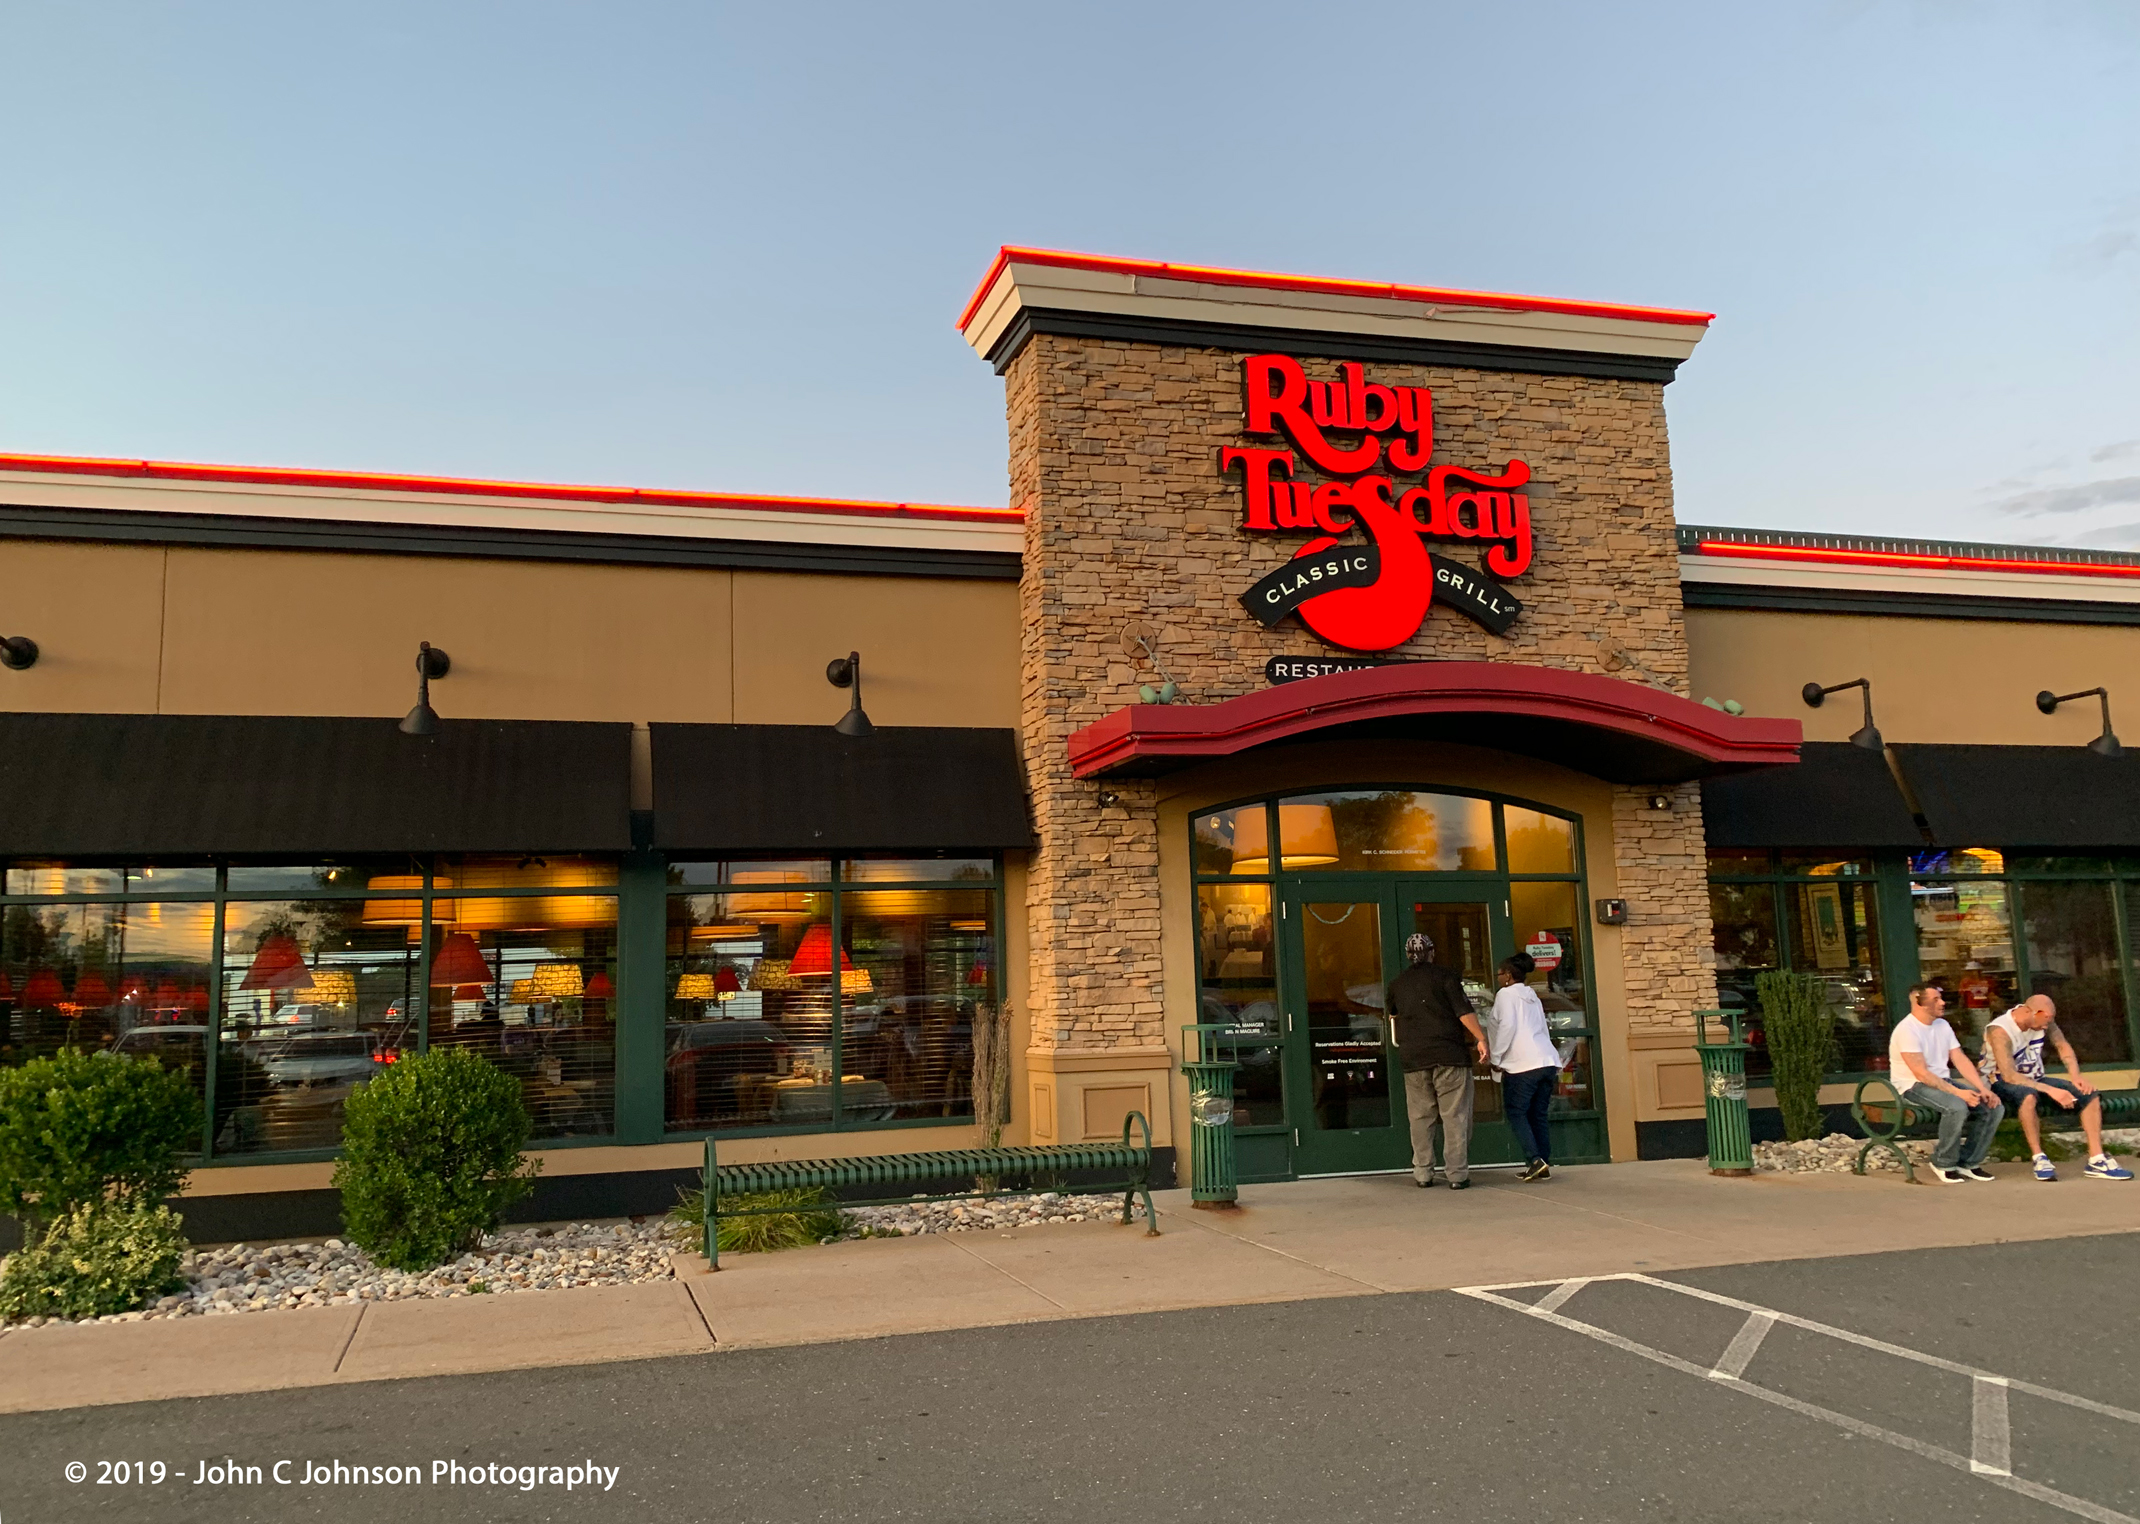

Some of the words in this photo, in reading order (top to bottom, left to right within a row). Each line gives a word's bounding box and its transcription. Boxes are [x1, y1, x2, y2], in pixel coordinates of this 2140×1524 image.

[1243, 354, 1433, 474] Ruby
[1222, 445, 1532, 650] Tuesday
[1265, 557, 1368, 605] CLASSIC
[1436, 568, 1501, 615] GRILL
